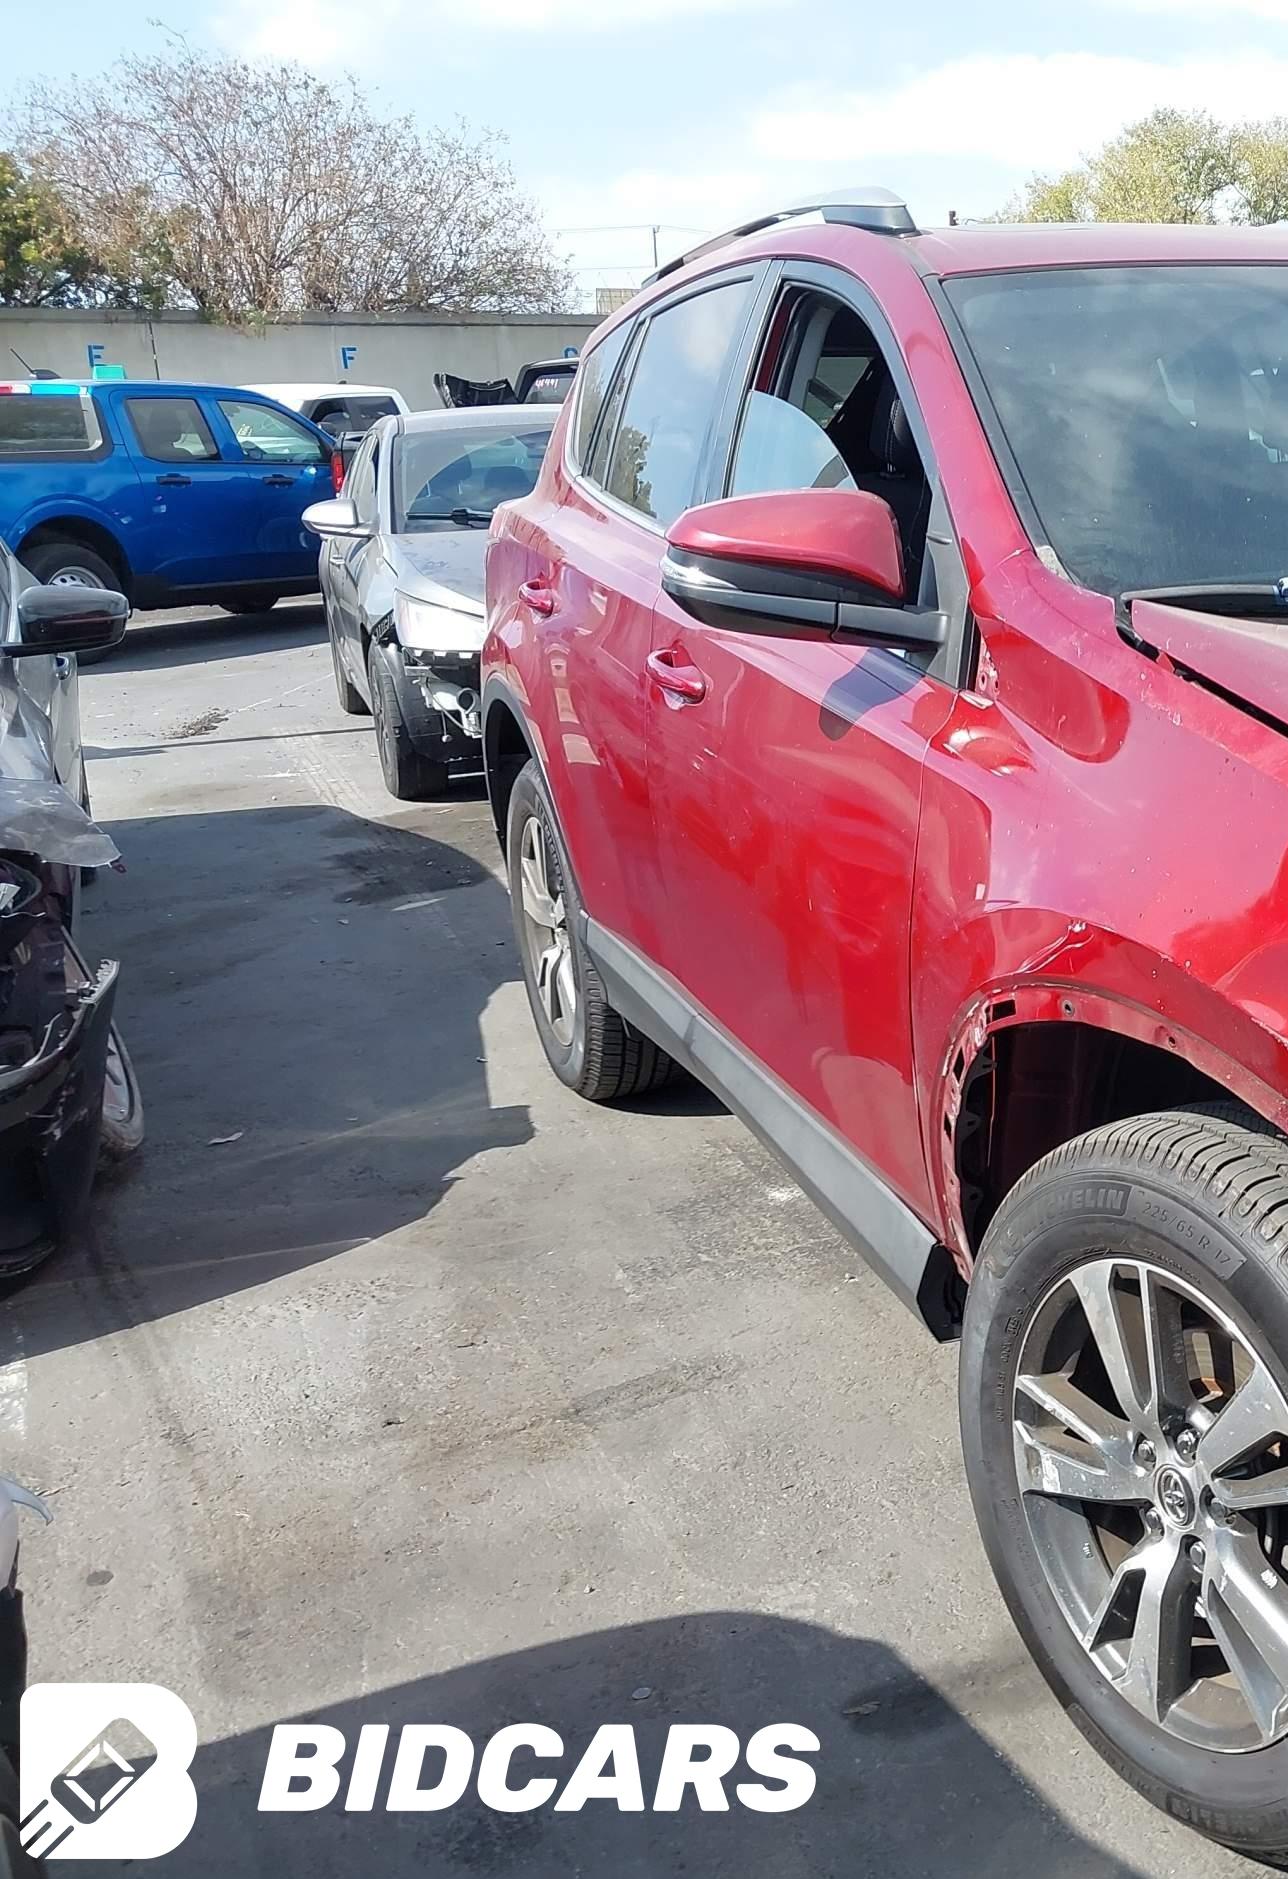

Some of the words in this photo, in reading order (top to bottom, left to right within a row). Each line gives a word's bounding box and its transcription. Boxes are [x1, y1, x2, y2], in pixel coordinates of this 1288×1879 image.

[341, 347, 357, 370] F
[1141, 1201, 1194, 1239] 225/65
[1197, 1234, 1211, 1250] R
[1214, 1248, 1232, 1265] 17
